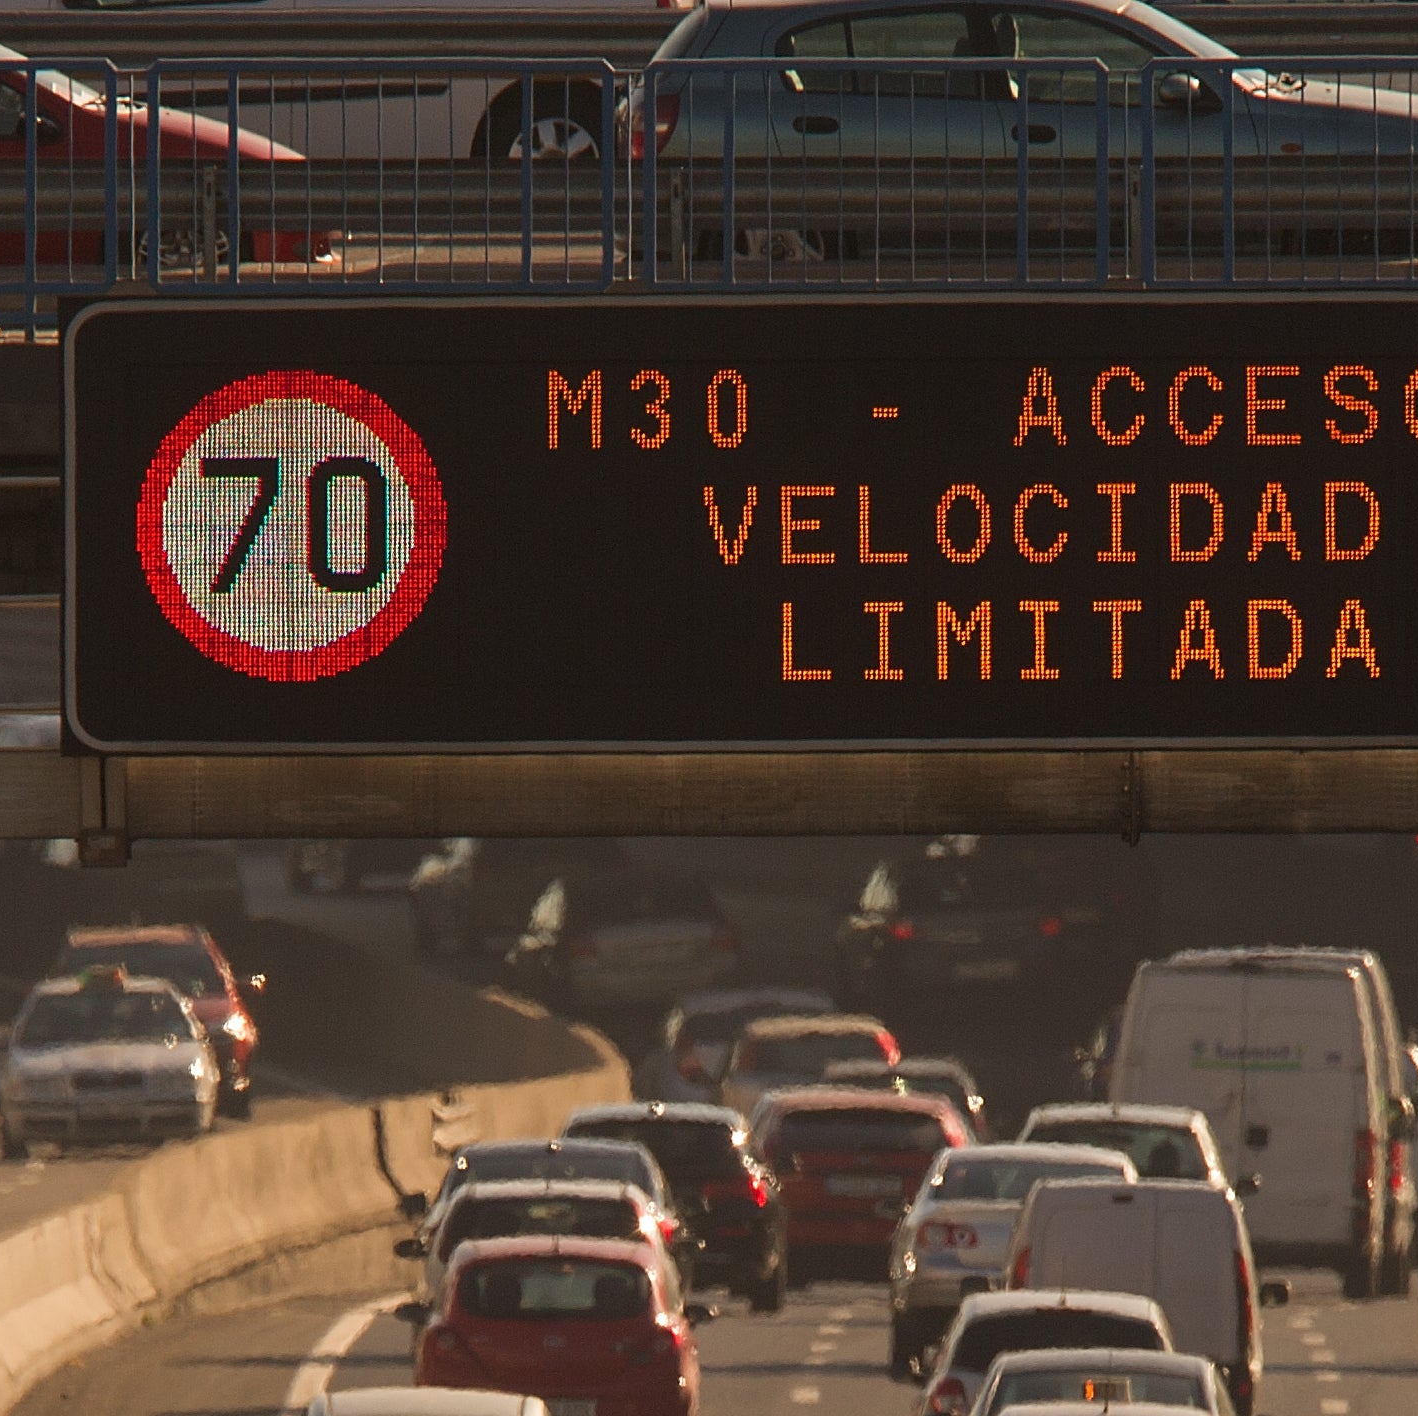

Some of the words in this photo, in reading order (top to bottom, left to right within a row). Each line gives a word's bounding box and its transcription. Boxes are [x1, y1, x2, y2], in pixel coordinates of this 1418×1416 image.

[546, 367, 750, 451] M30
[200, 457, 388, 594] 70
[702, 480, 1383, 567] VELOCIDAD
[781, 598, 1383, 683] LIMITADA
